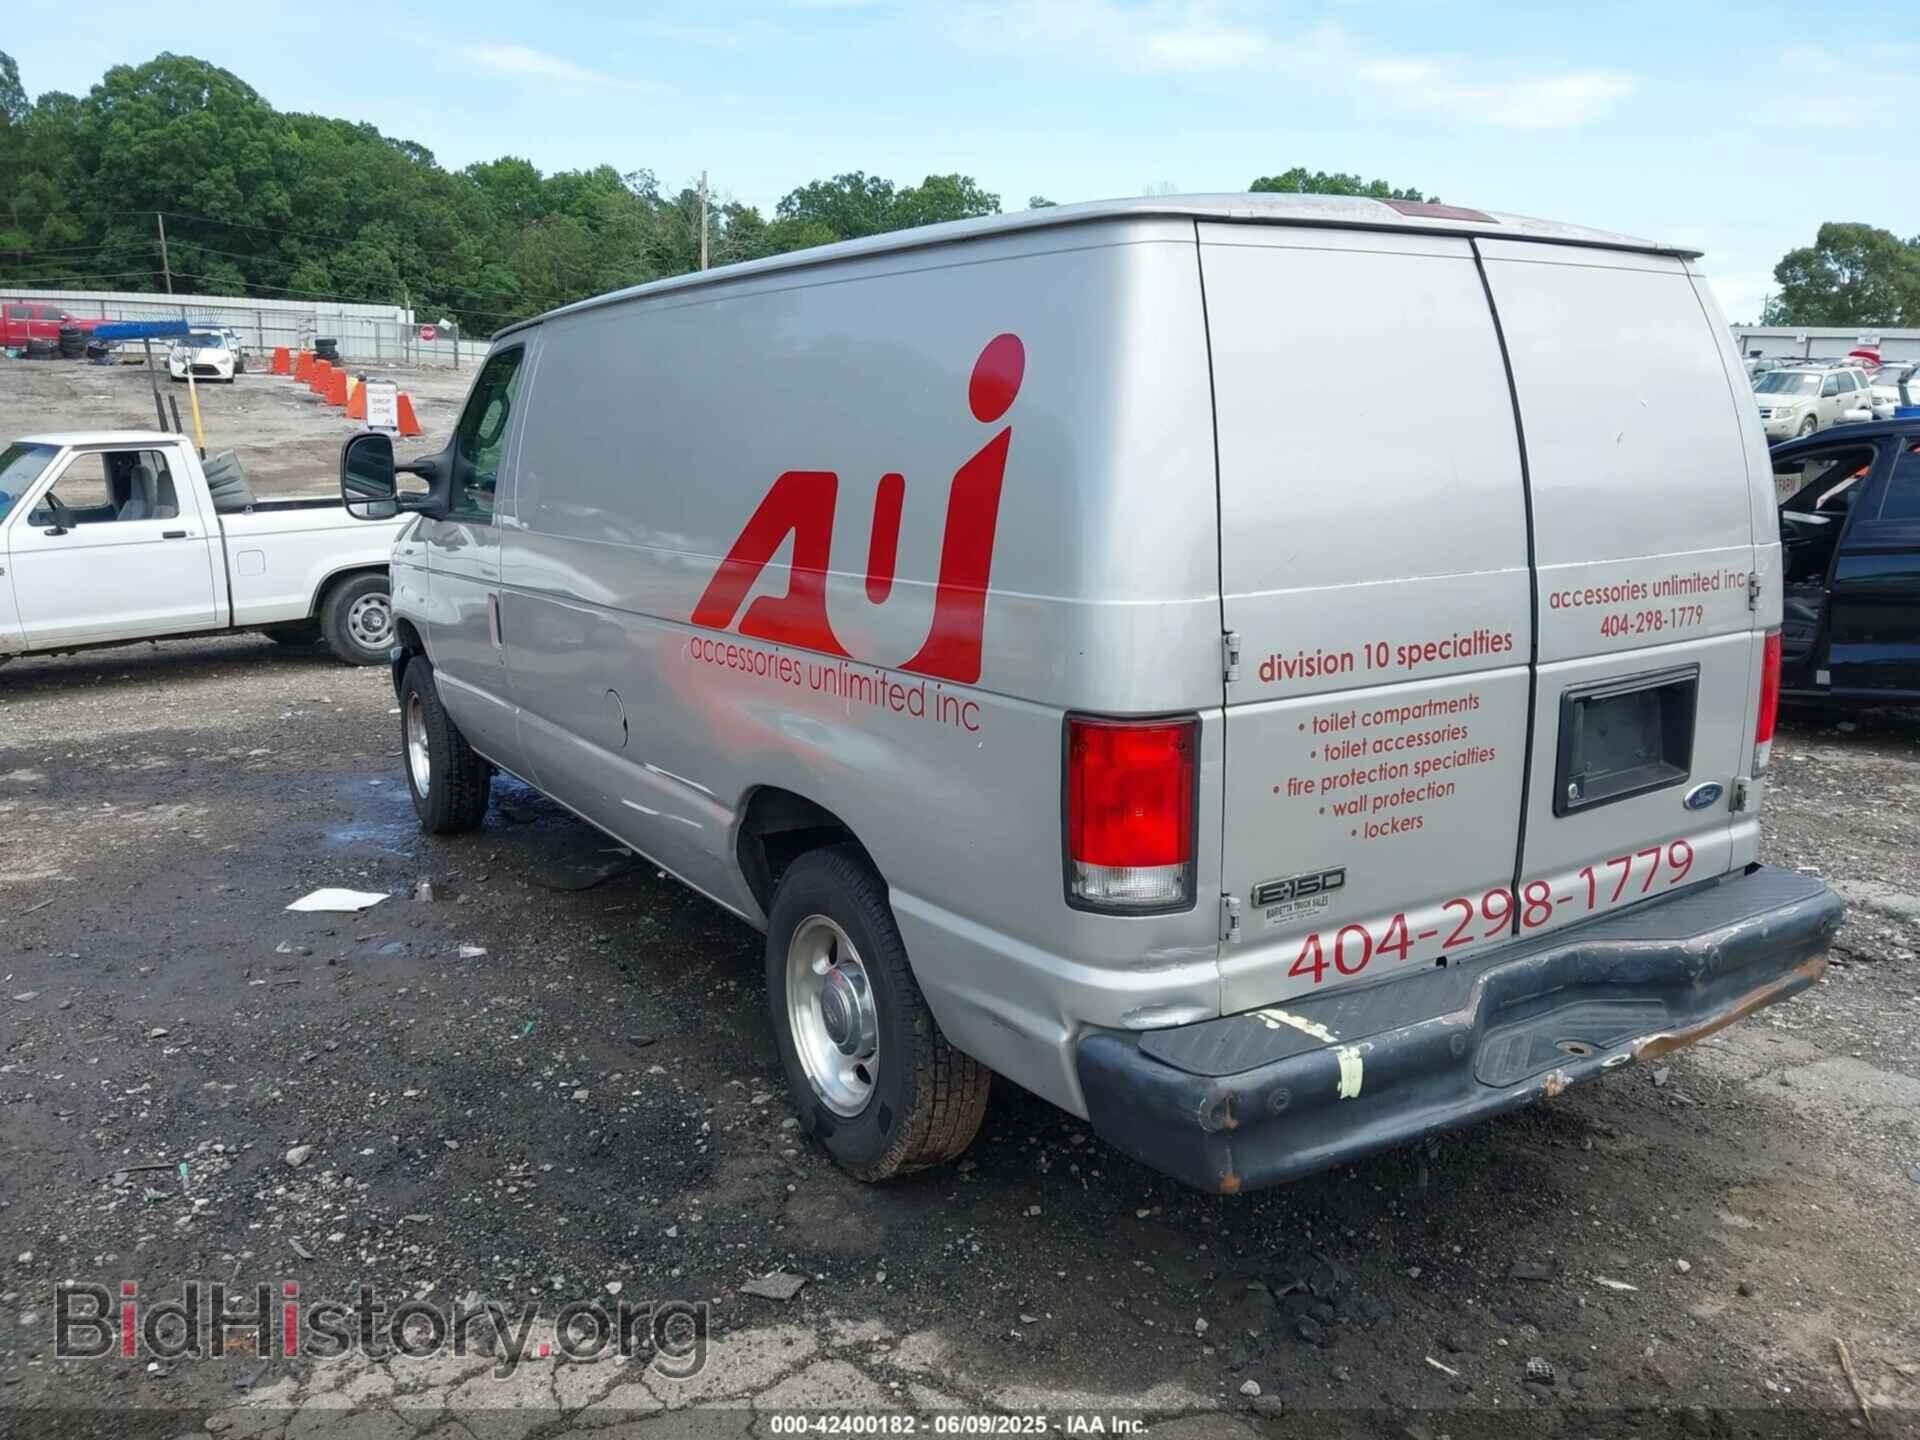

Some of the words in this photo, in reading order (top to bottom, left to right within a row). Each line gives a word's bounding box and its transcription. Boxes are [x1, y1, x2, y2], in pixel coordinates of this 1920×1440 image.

[1549, 579, 1648, 609] accessories
[1653, 570, 1720, 598] unlimited
[1724, 569, 1745, 589] inc
[1600, 605, 1704, 637] 404-298-1779
[1259, 649, 1354, 682] division
[1365, 641, 1389, 669] 10
[1397, 629, 1513, 670] specialties
[690, 636, 801, 685] accessories
[809, 661, 926, 718] unlimited
[936, 684, 980, 731] inc
[1312, 711, 1356, 734] toilet
[1361, 693, 1480, 726] compartments
[1324, 738, 1367, 761] toilet
[1373, 724, 1468, 754] accessories
[1287, 777, 1315, 797] fire
[1321, 762, 1409, 795] protection
[1414, 746, 1495, 777] specialties
[1333, 795, 1367, 816] wall
[1373, 781, 1456, 813] protection
[1364, 815, 1424, 839] lockers
[1288, 839, 1694, 983] 404-298-1779
